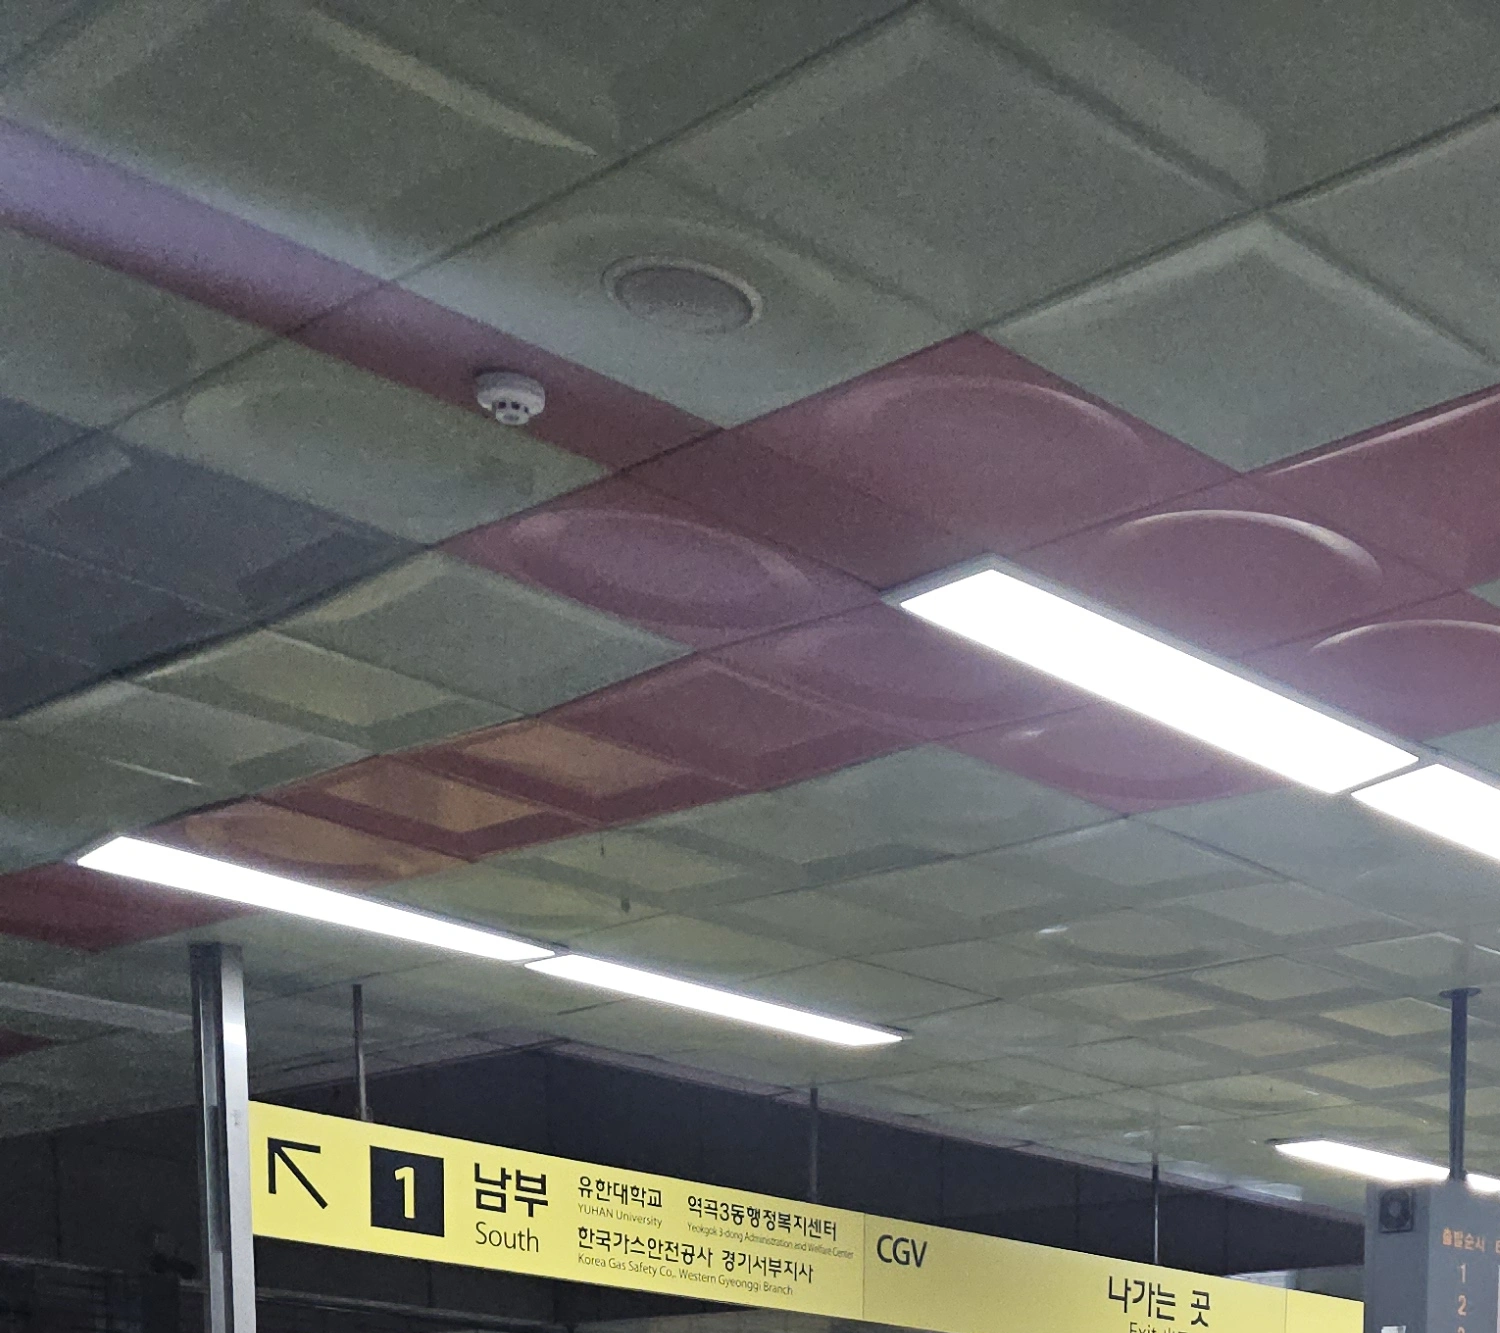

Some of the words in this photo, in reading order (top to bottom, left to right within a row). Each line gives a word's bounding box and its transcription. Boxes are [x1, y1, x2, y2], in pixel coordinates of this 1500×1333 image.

[394, 1166, 416, 1219] 1
[474, 1162, 549, 1218] 남부
[577, 1175, 664, 1209] 유한대학교
[688, 1194, 838, 1242] 역곡3동행정복지센터
[475, 1221, 540, 1253] South
[577, 1203, 614, 1219] YUHAN
[616, 1209, 664, 1229] University
[577, 1226, 714, 1268] 한국가스안전공사
[721, 1249, 814, 1284] 경기서부지사
[876, 1234, 928, 1268] CGV
[577, 1252, 607, 1268] Korea
[608, 1256, 627, 1271] Gas
[628, 1260, 657, 1279] Safety
[678, 1268, 717, 1285] Western
[718, 1274, 763, 1293] Gyeonggi
[763, 1279, 794, 1296] Branch
[1459, 1264, 1468, 1284] 1
[1108, 1275, 1176, 1321] 나가는
[1190, 1289, 1211, 1328] 곳
[1458, 1295, 1468, 1317] 2
